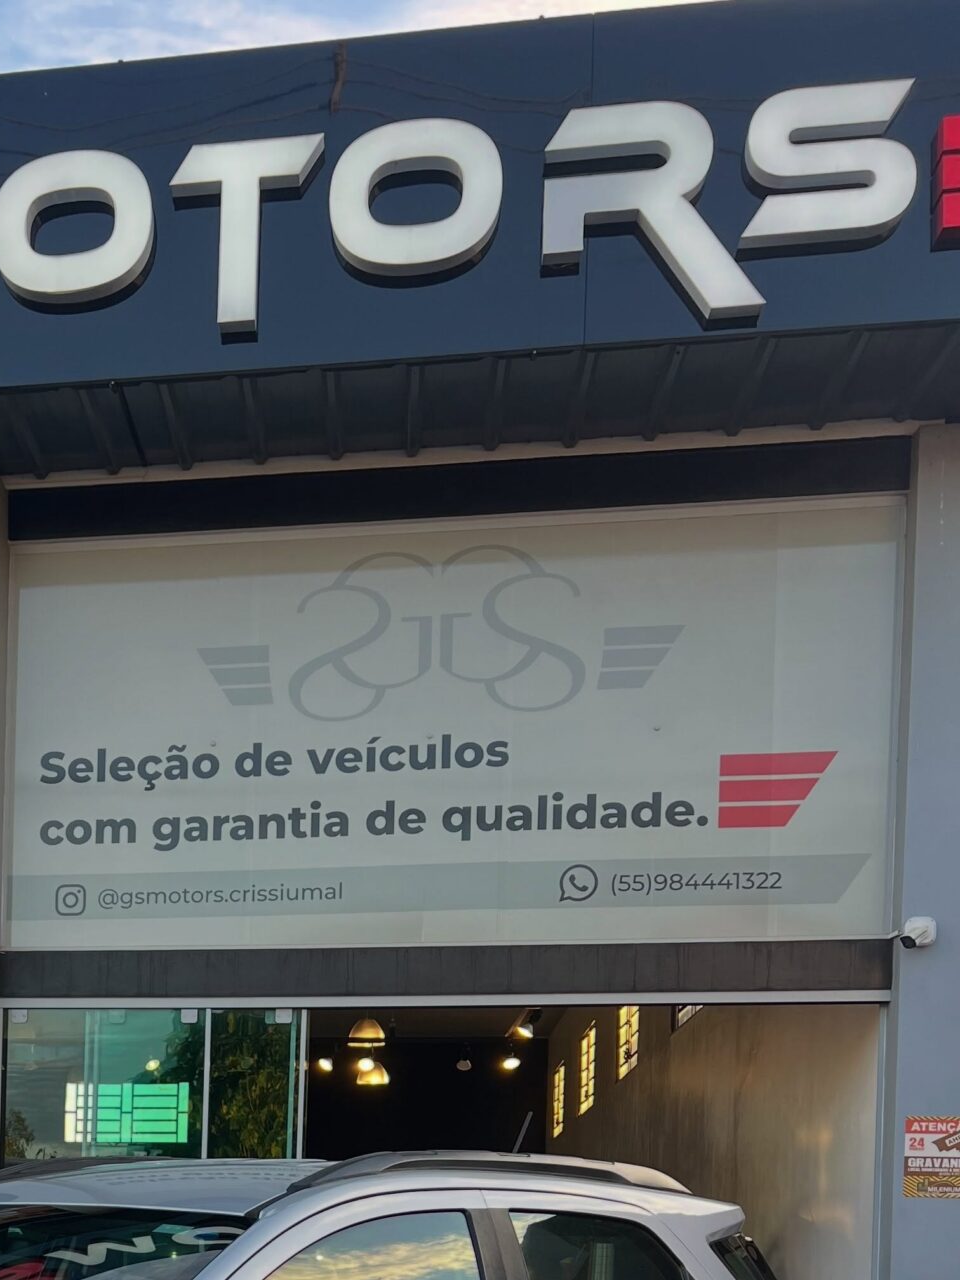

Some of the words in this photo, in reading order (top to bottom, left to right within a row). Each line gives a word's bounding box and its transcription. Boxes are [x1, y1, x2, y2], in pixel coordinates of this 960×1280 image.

[40, 744, 220, 791] Seleção
[234, 742, 292, 777] de
[307, 734, 509, 775] veículos
[40, 816, 136, 846] com
[152, 800, 349, 851] garantia
[365, 800, 426, 836] de
[442, 792, 708, 841] qualidade.
[97, 881, 343, 910] @gsmotors.crissiumal
[610, 871, 782, 898] (55)984441322
[911, 1121, 960, 1133] ATENÇ
[909, 1137, 925, 1148] 24
[907, 1157, 960, 1169] GRAVAN
